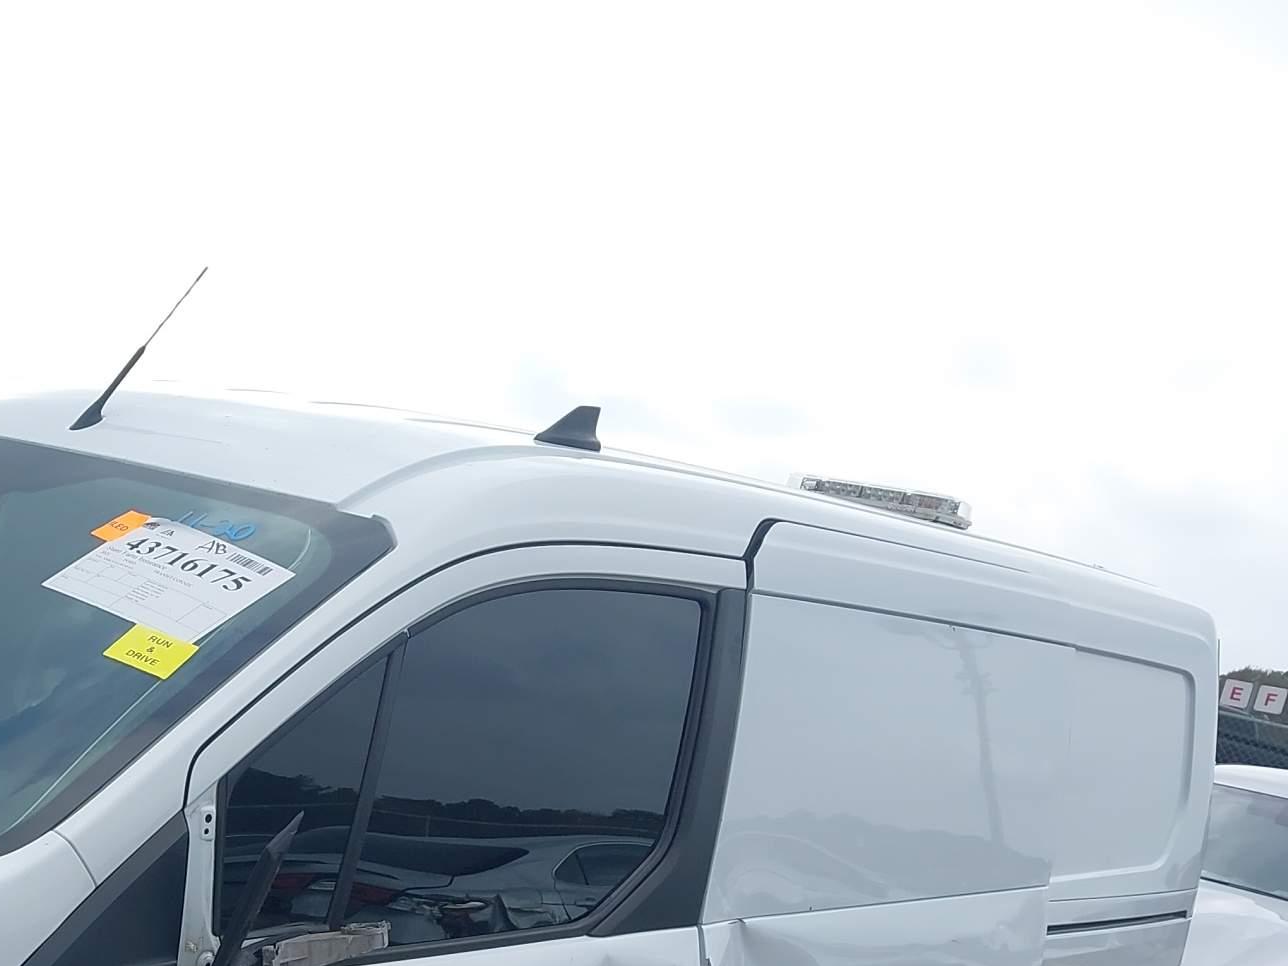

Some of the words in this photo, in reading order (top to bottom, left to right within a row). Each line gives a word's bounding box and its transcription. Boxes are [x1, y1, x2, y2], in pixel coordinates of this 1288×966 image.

[126, 538, 252, 591] 43716175
[147, 635, 174, 648] RUN
[126, 649, 160, 666] DRIVE
[1230, 687, 1243, 701] E
[1264, 692, 1278, 706] F
